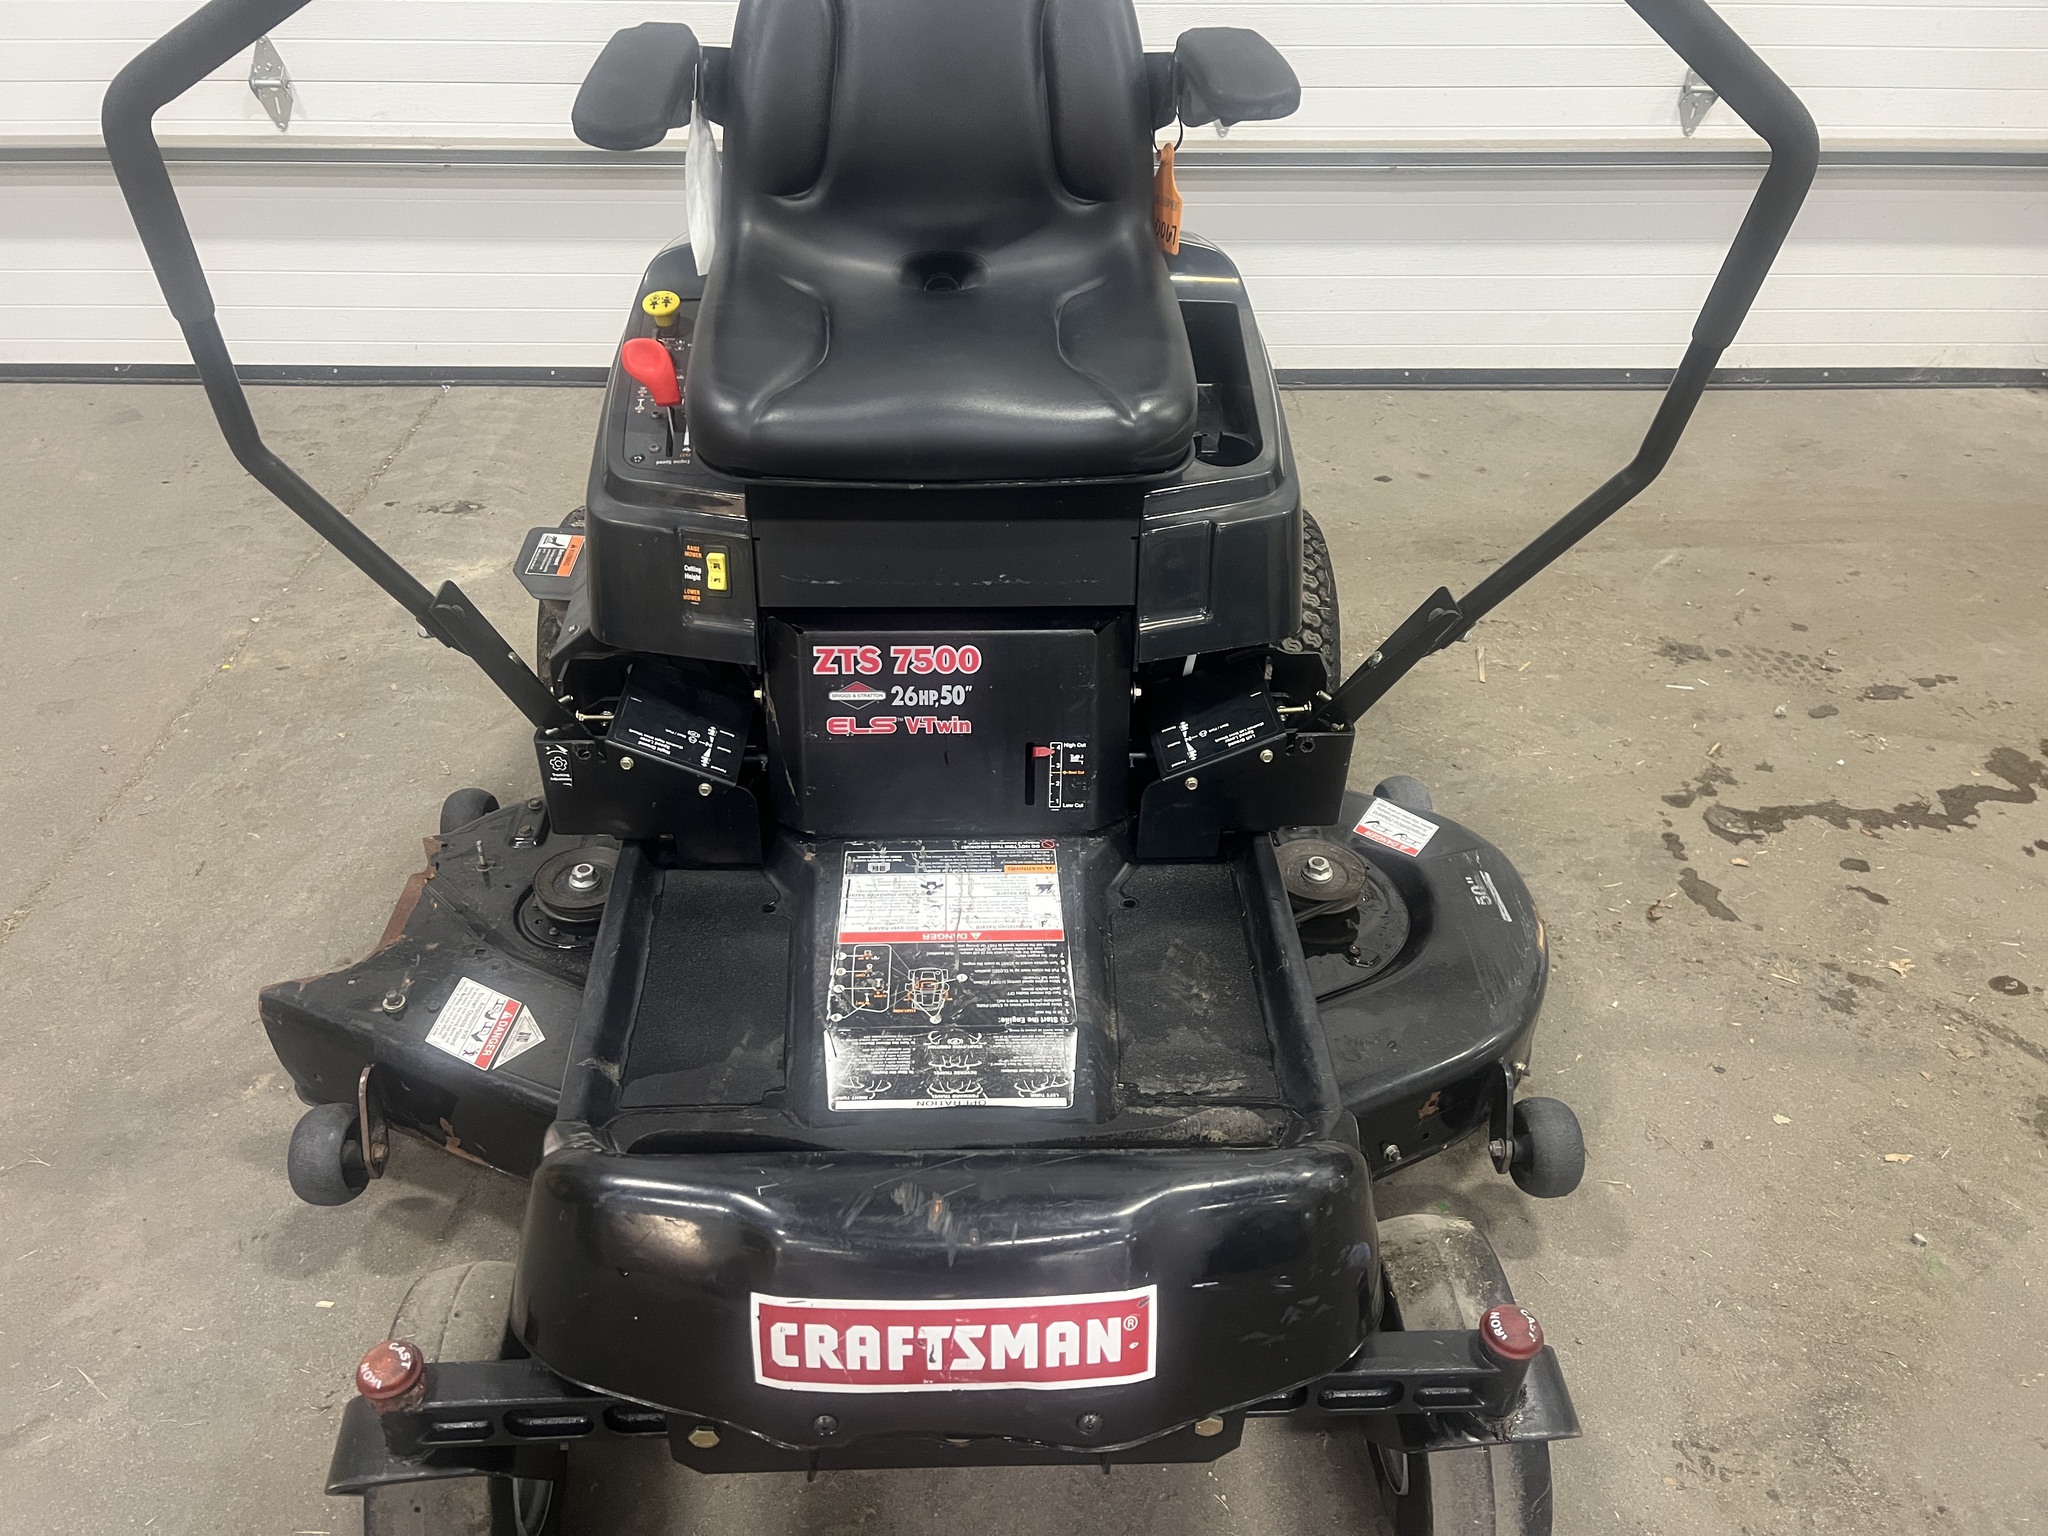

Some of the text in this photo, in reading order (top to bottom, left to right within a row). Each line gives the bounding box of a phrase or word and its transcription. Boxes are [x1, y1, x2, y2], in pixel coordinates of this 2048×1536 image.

[684, 564, 701, 573] Cutting
[684, 572, 700, 581] Height
[813, 645, 982, 675] ZTS 7500
[905, 716, 972, 734] V-Twin
[1364, 830, 1399, 847] DANGER
[482, 1019, 509, 1056] DANGER
[916, 1099, 986, 1107] OPERATION
[1490, 1311, 1508, 1341] IRON
[389, 1342, 412, 1370] CAST
[360, 1362, 382, 1389] IRON
